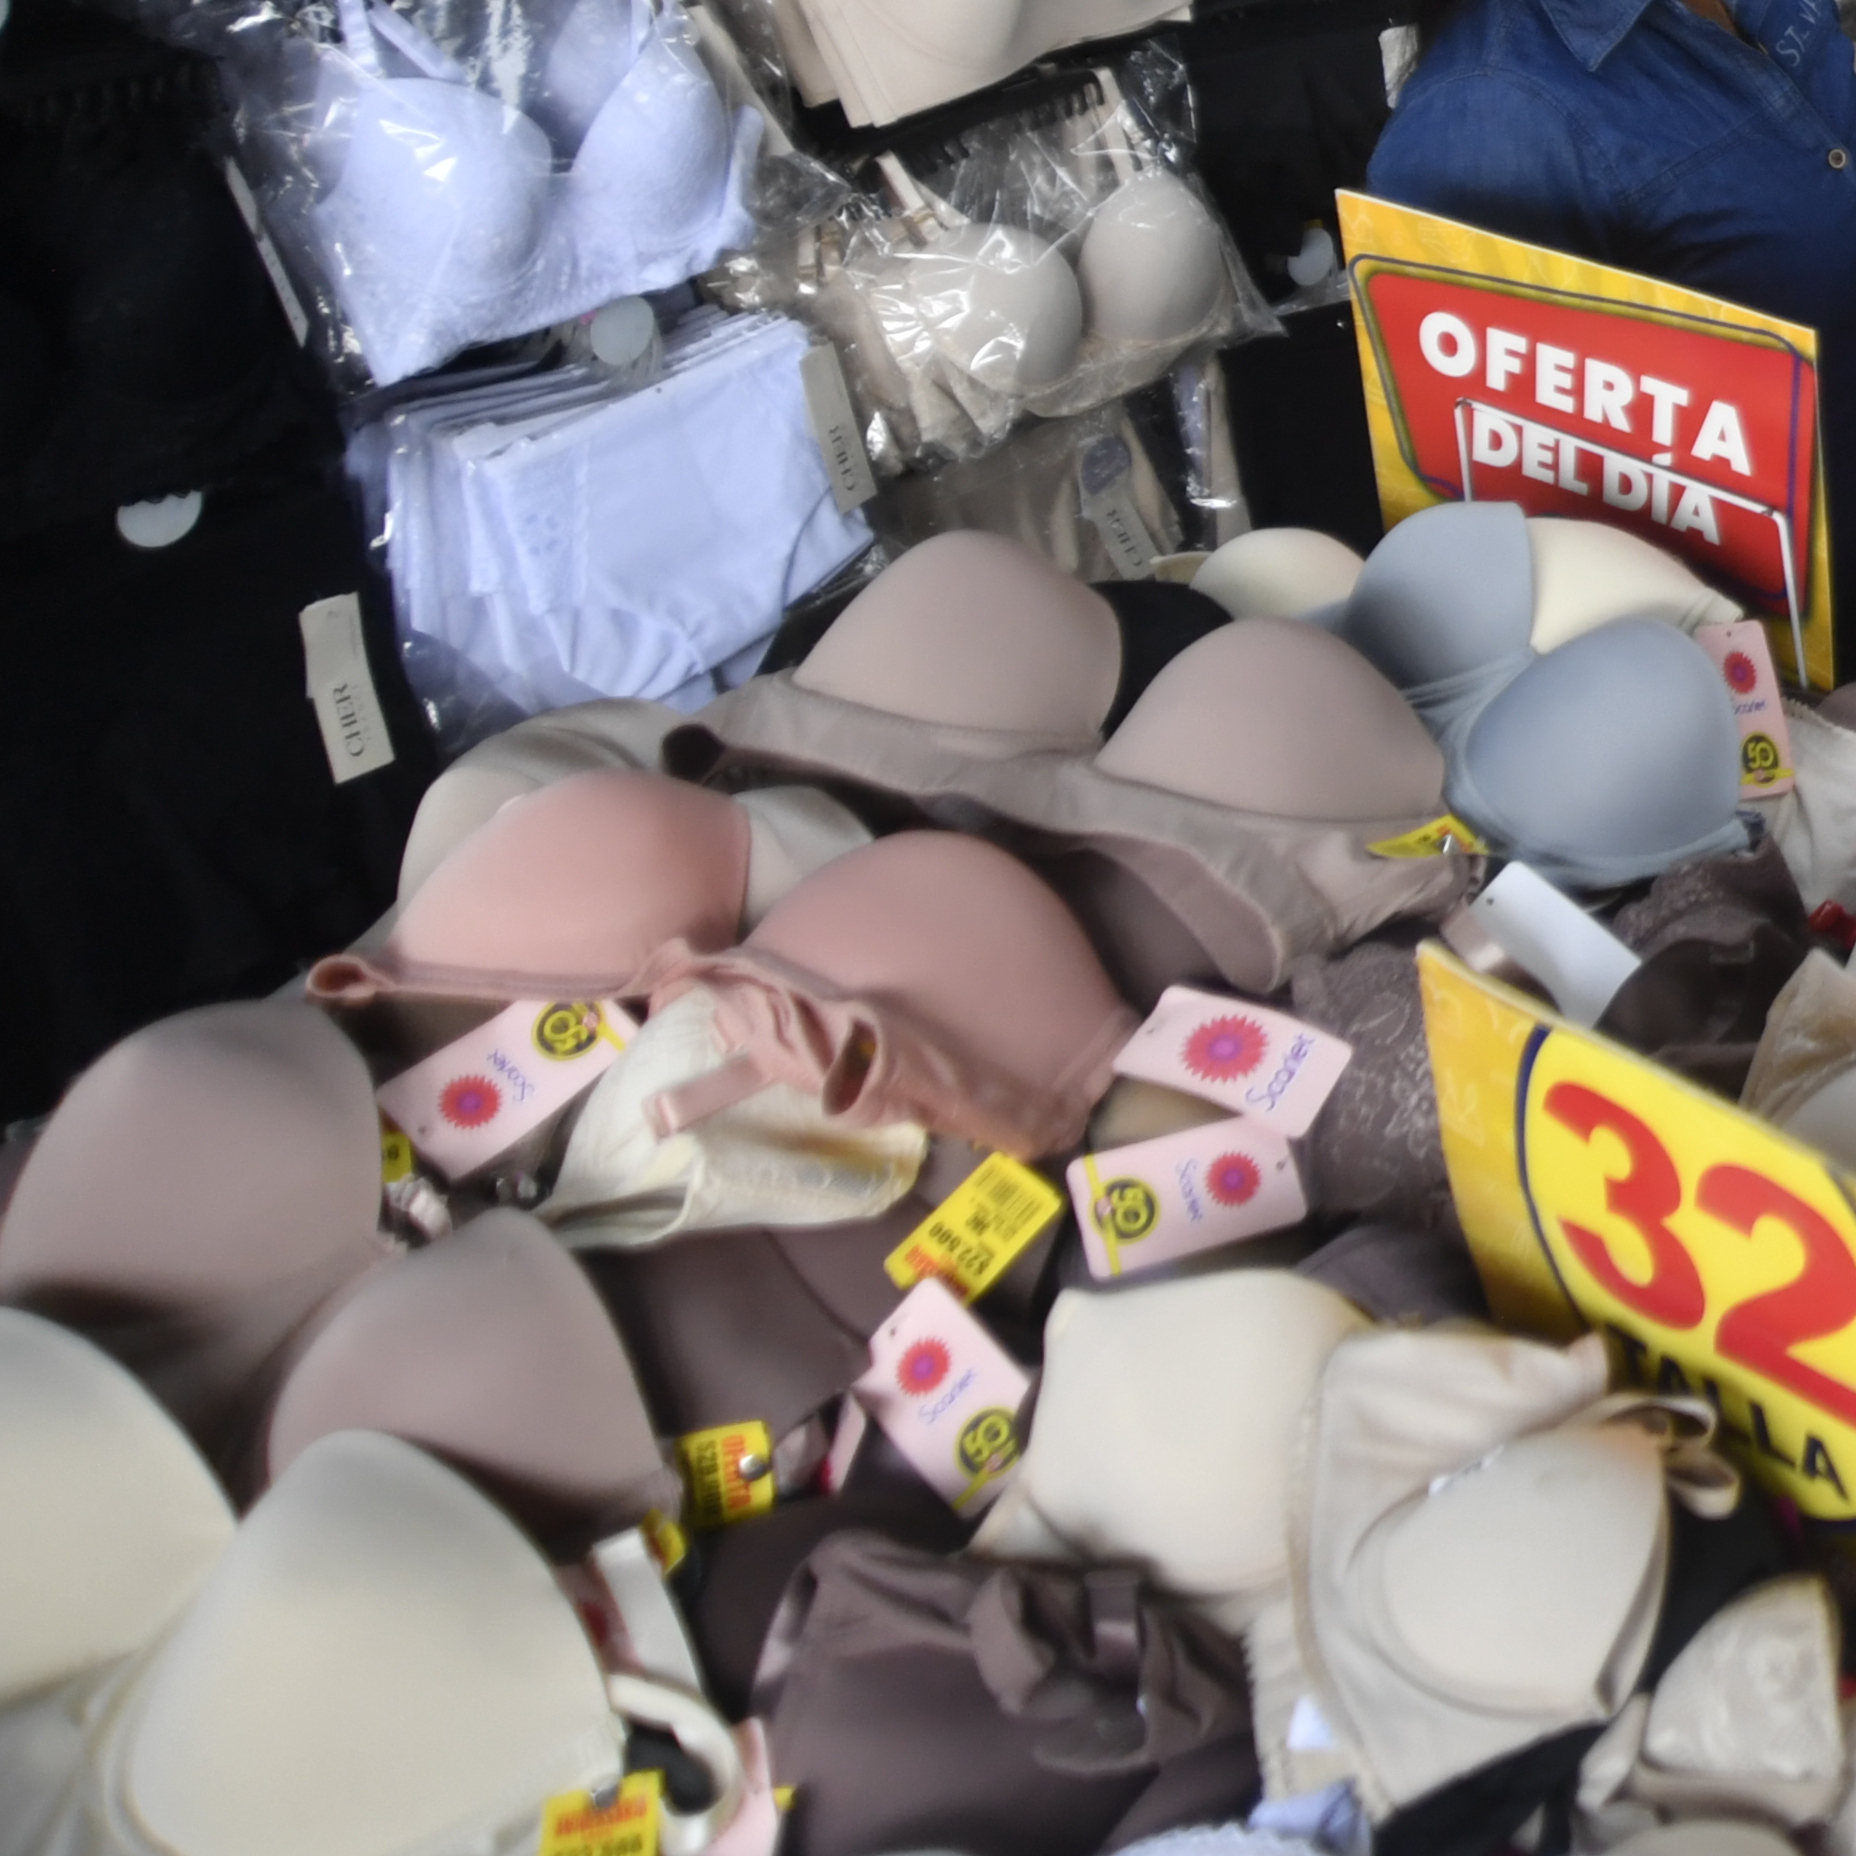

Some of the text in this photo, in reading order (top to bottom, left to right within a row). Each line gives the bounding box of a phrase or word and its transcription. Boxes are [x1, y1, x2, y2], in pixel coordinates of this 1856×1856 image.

[1417, 310, 1753, 479] OFERTA
[1472, 408, 1721, 547] DEL DÍA
[332, 681, 365, 758] CHER
[1244, 1033, 1316, 1112] Scarlet
